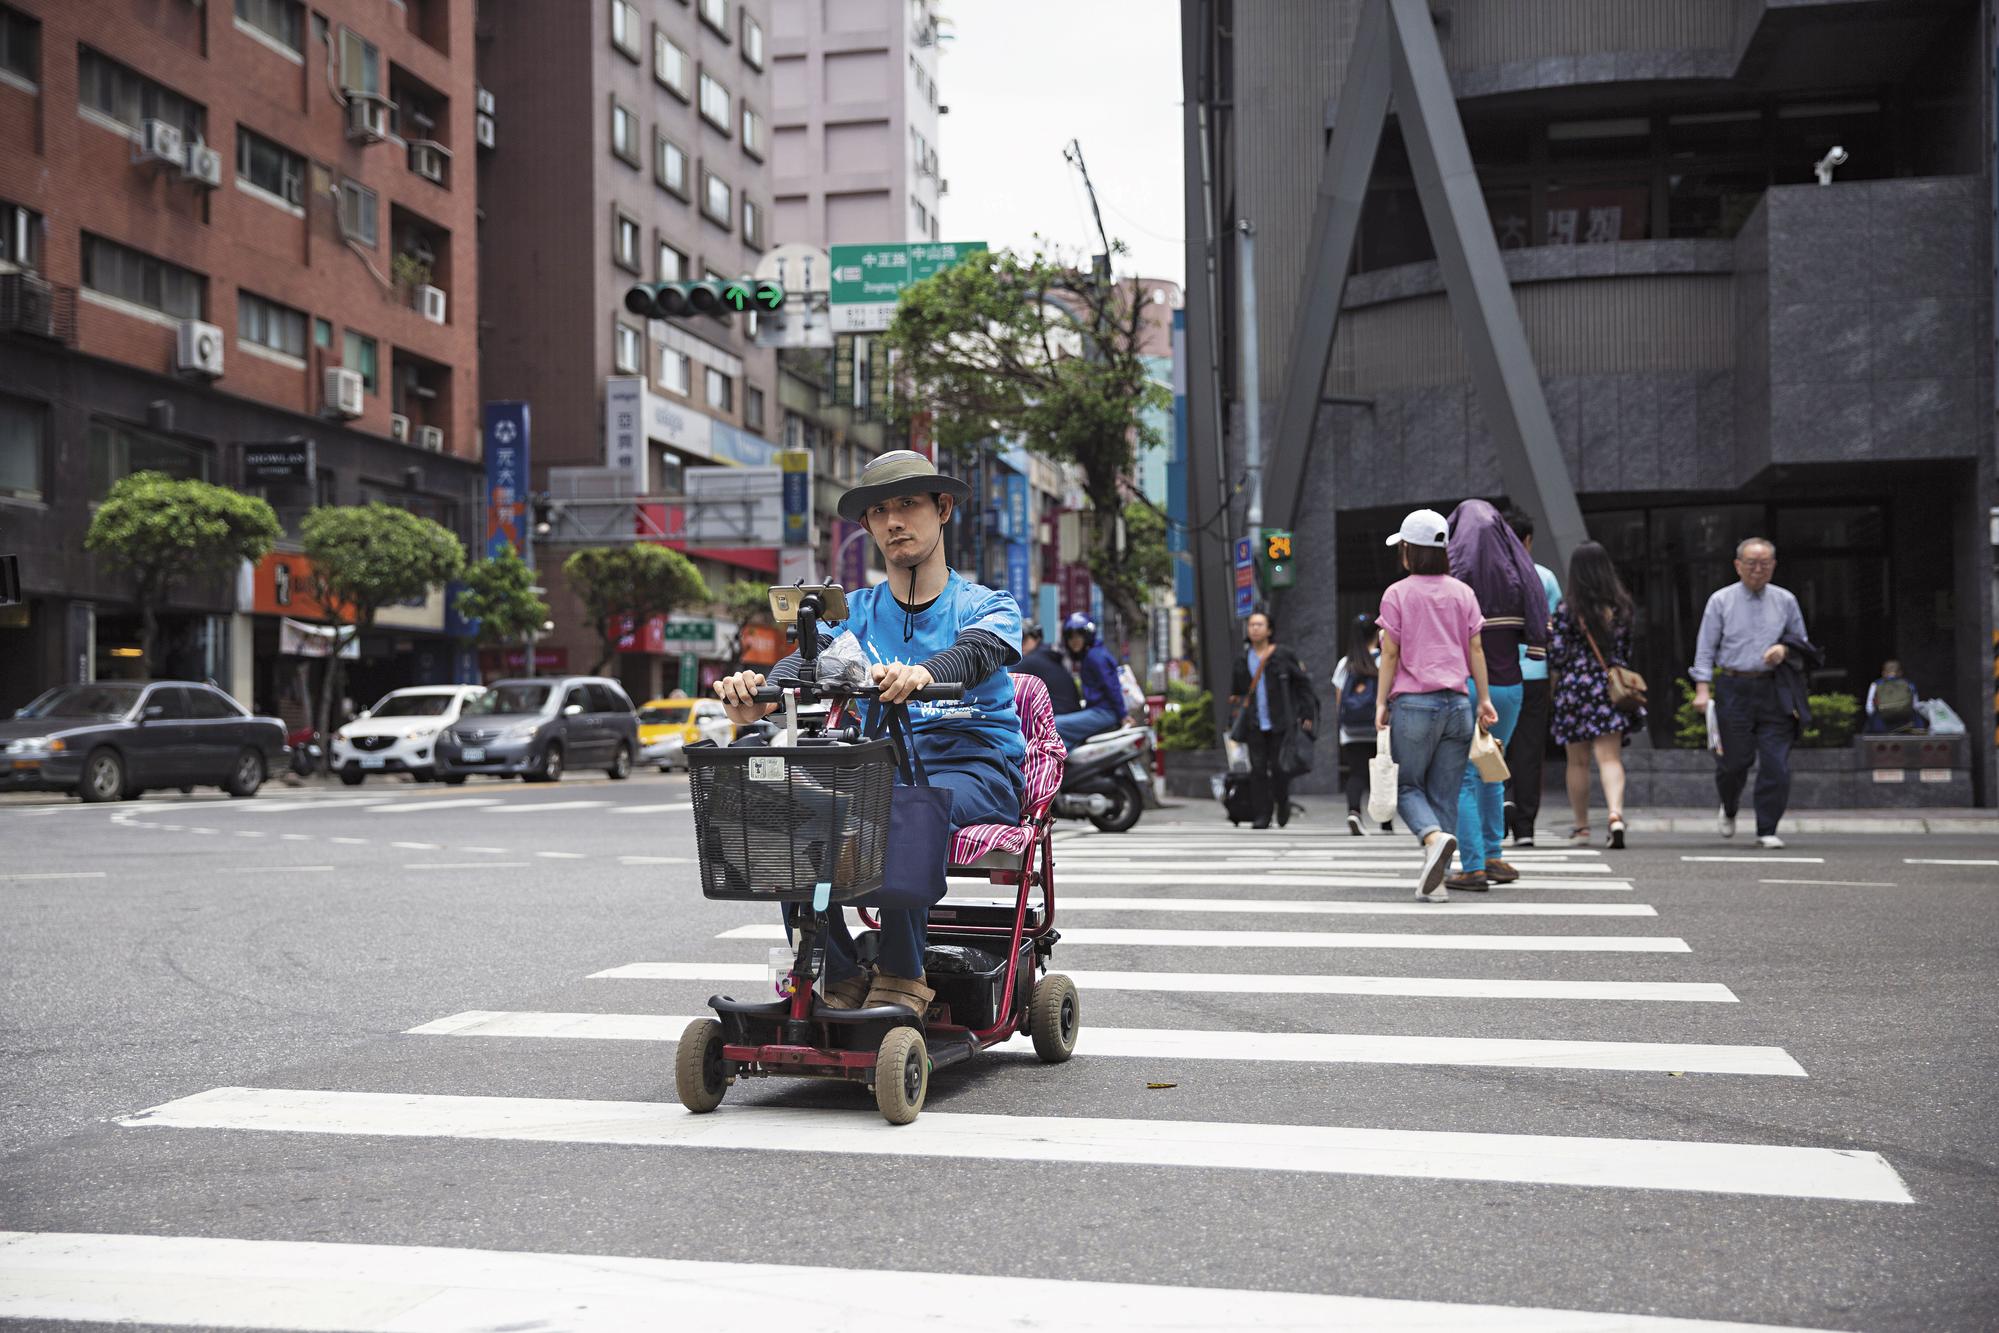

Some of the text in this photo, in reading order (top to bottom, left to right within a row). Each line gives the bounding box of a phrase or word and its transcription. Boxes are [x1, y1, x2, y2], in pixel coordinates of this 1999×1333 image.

[862, 251, 907, 269] 中正路
[911, 244, 957, 262] 中山路
[1268, 536, 1292, 559] 24
